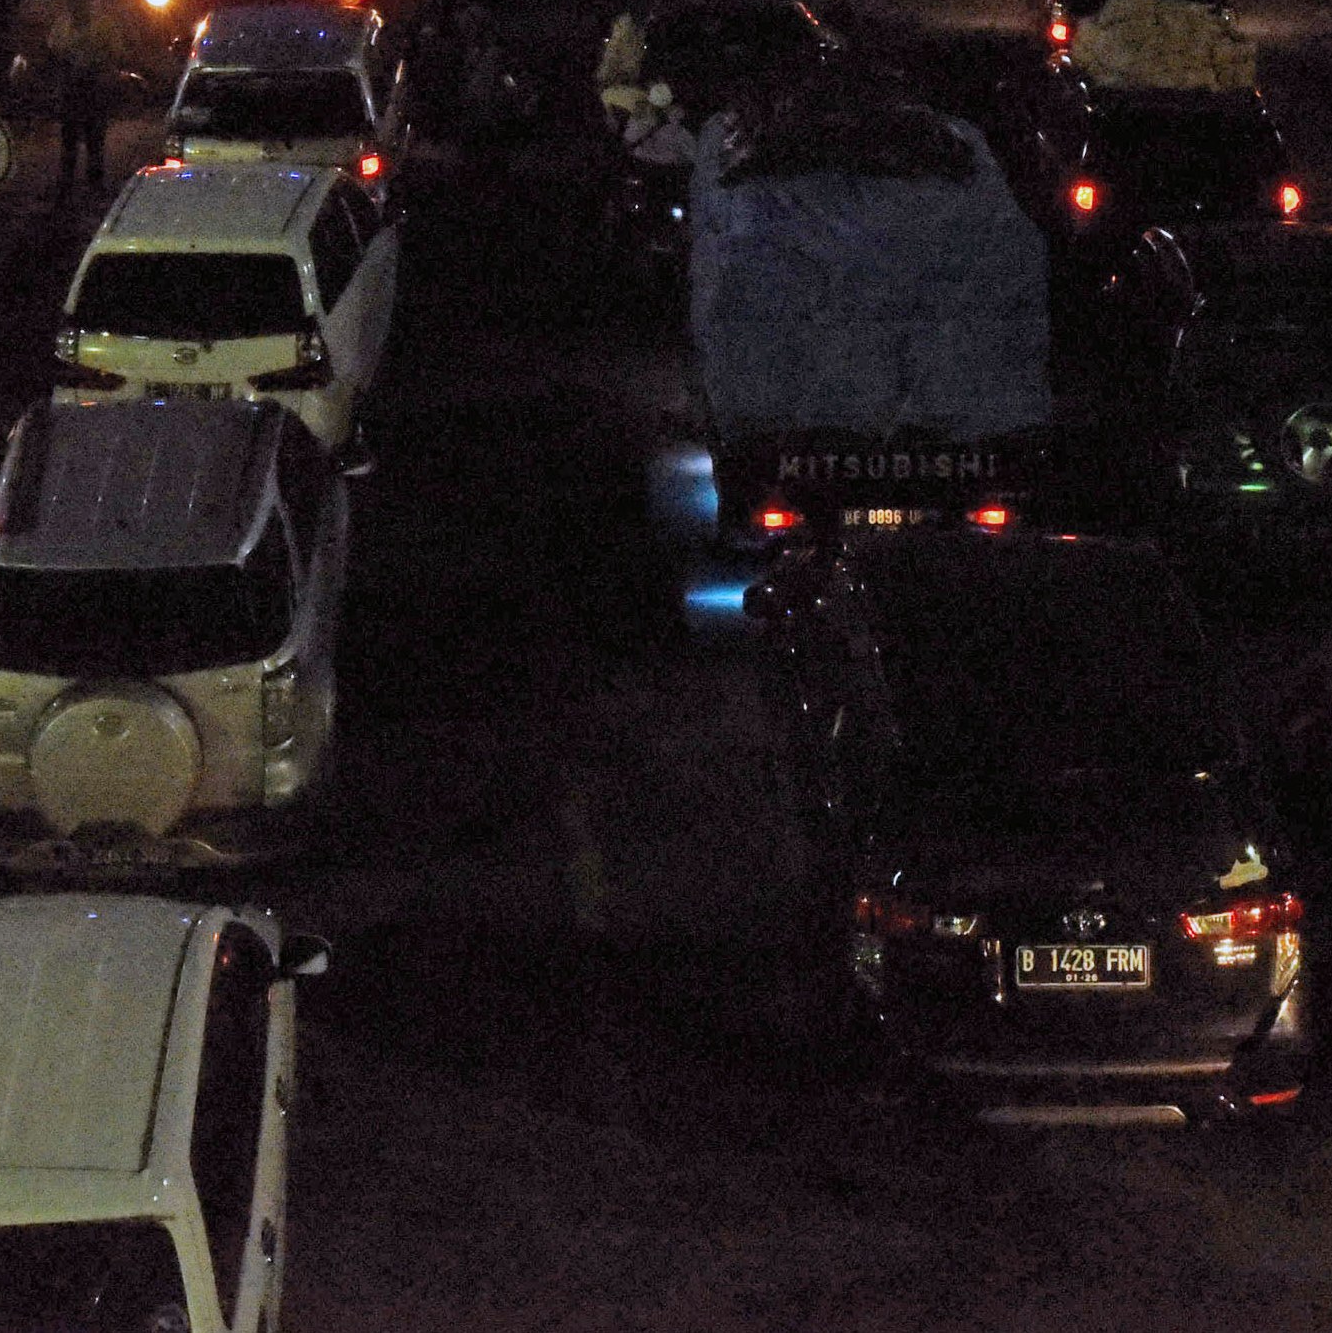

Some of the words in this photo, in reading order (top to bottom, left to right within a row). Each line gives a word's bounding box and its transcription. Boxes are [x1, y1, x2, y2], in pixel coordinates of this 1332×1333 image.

[779, 453, 996, 479] MITSUBISHI
[868, 508, 902, 525] 8896
[1022, 949, 1034, 971] B
[1050, 948, 1095, 972] 1428
[1106, 948, 1144, 972] FRM
